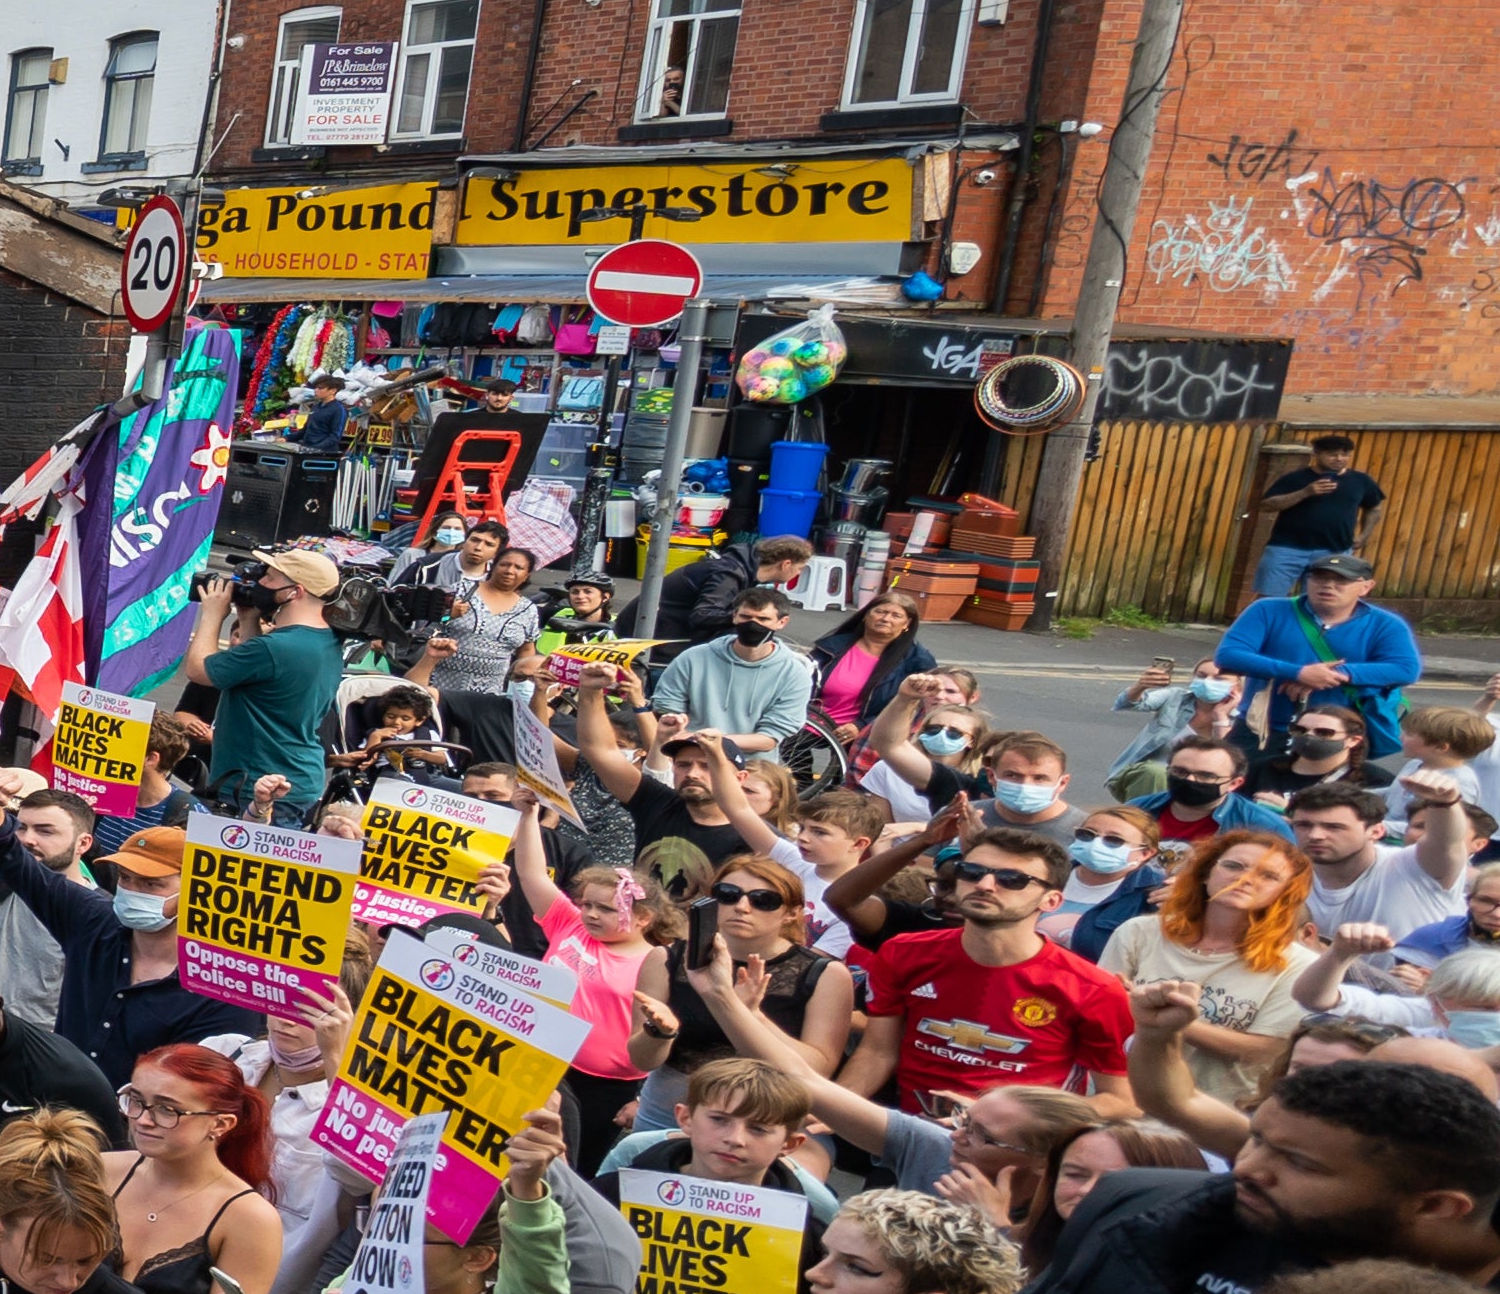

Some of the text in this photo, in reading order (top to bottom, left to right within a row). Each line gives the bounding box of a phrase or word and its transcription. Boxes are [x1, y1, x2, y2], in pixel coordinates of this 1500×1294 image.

[329, 46, 383, 55] For Sale
[320, 77, 383, 87] 0161 445 9700
[308, 115, 382, 125] FOR SALE
[268, 187, 438, 233] Pound
[488, 177, 889, 238] Superstore
[131, 235, 176, 292] 20
[235, 252, 356, 270] HOUSEHOLD
[254, 842, 322, 864] TO RACISM
[255, 831, 317, 850] STAND UP
[192, 849, 342, 904] DEFEND
[189, 879, 301, 930] ROMA
[187, 907, 327, 965] RIGHTS
[185, 941, 300, 987] Oppose the
[187, 962, 285, 1004] Police Bill
[914, 1040, 1027, 1074] CHEVROLET
[352, 1246, 396, 1289] NOW
